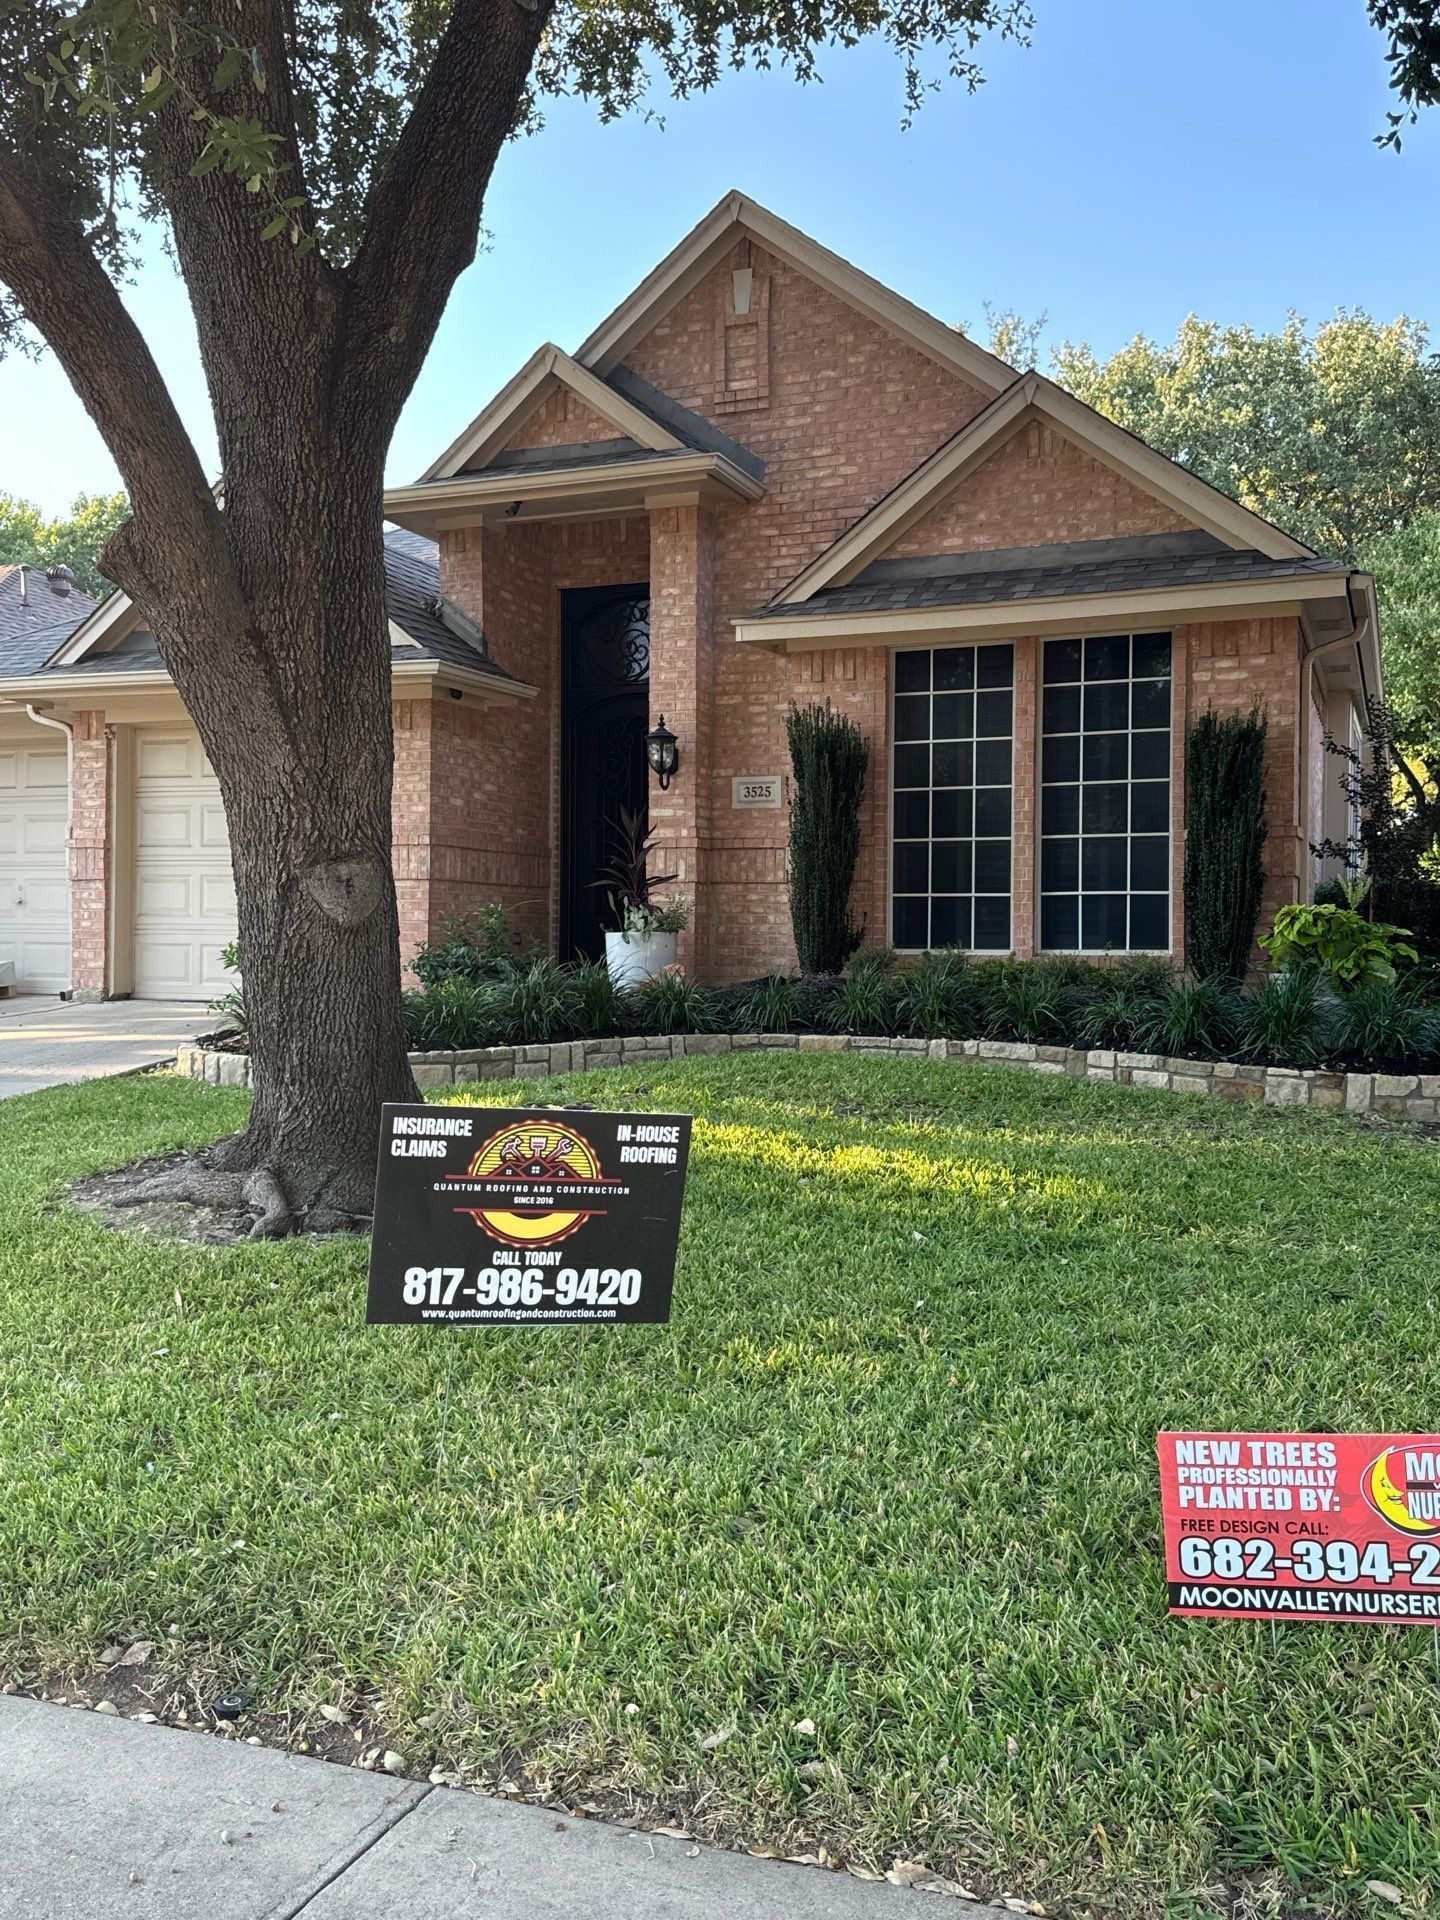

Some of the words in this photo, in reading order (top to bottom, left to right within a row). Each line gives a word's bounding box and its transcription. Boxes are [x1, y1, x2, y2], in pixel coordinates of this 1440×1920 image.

[744, 786, 772, 798] 3525
[392, 1117, 473, 1136] INSURANCE
[617, 1125, 680, 1143] IN-HOUSE
[391, 1139, 447, 1157] CLAIMS
[620, 1146, 677, 1164] ROOFING
[433, 1183, 482, 1192] QUANTUM
[486, 1184, 529, 1193] ROOFING
[533, 1185, 552, 1193] AND
[556, 1186, 630, 1195] CONSTRUCTION
[513, 1196, 535, 1204] SINCE
[536, 1196, 554, 1205] 2016
[492, 1251, 521, 1265] CALL
[525, 1251, 562, 1266] TODAY
[402, 1267, 642, 1306] 817-986-9420
[422, 1308, 616, 1320] www.quantumroofingandconstruction.com
[1175, 1440, 1241, 1466] NEW
[1247, 1441, 1337, 1468] TREES
[1177, 1467, 1337, 1487] PROFESSIONALLY
[1179, 1486, 1292, 1511] PLANTED
[1299, 1488, 1341, 1512] BY:
[1181, 1519, 1214, 1532] FREE
[1220, 1520, 1279, 1534] DESIGN
[1285, 1521, 1329, 1535] CALL:
